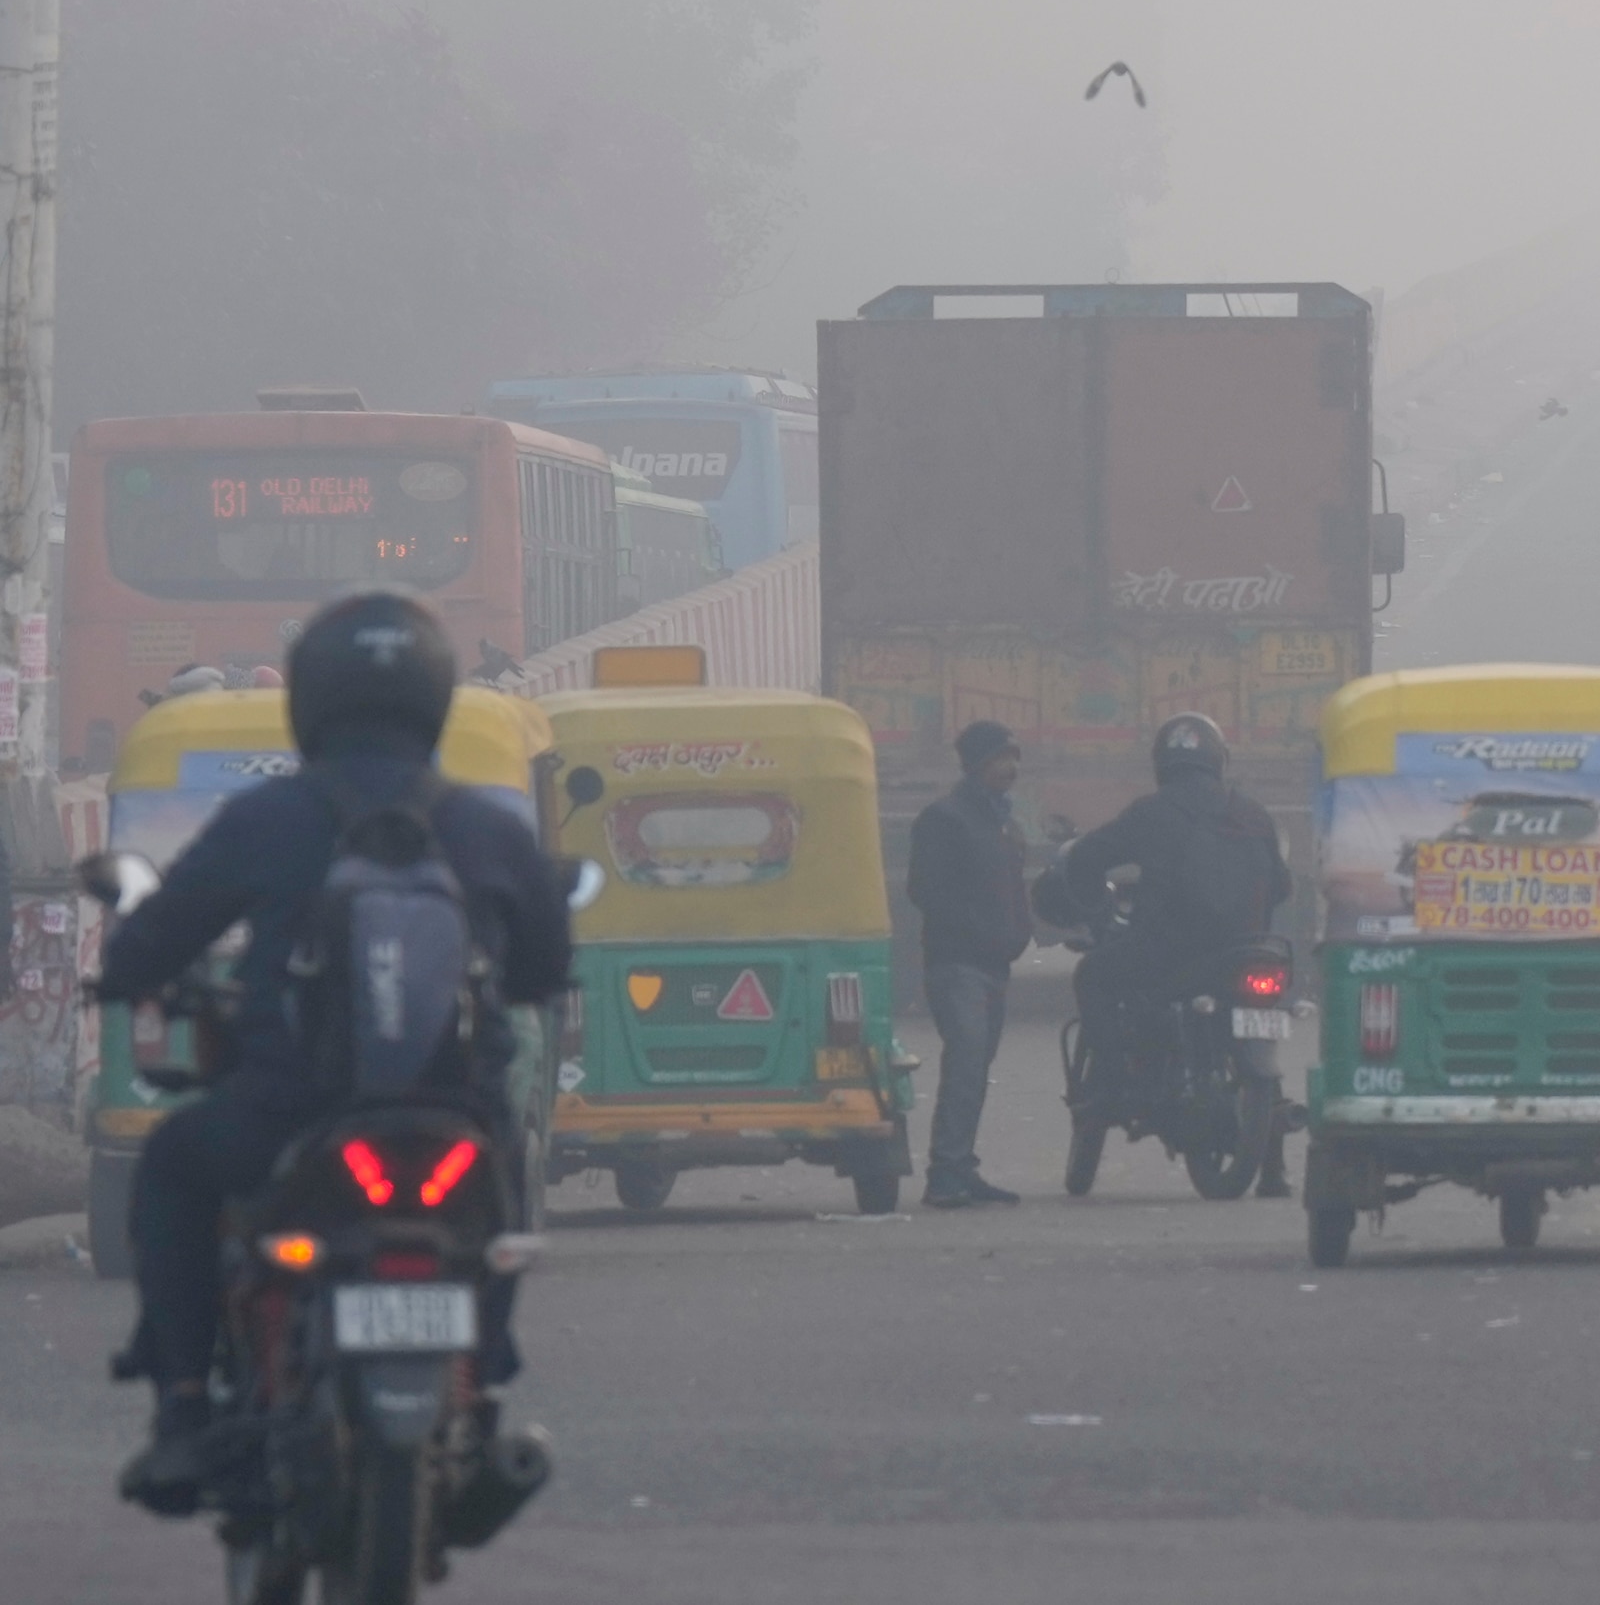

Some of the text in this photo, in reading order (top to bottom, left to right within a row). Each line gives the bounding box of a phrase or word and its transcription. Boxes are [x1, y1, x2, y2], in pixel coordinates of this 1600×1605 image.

[212, 479, 248, 518] 131
[261, 478, 369, 496] OLD DELHI
[282, 496, 374, 515] RAILWAY
[1492, 809, 1563, 836] Pal
[1441, 846, 1519, 871] CASH
[1461, 875, 1470, 902] 1
[1515, 876, 1541, 906] 70
[1353, 1066, 1404, 1094] CNG
